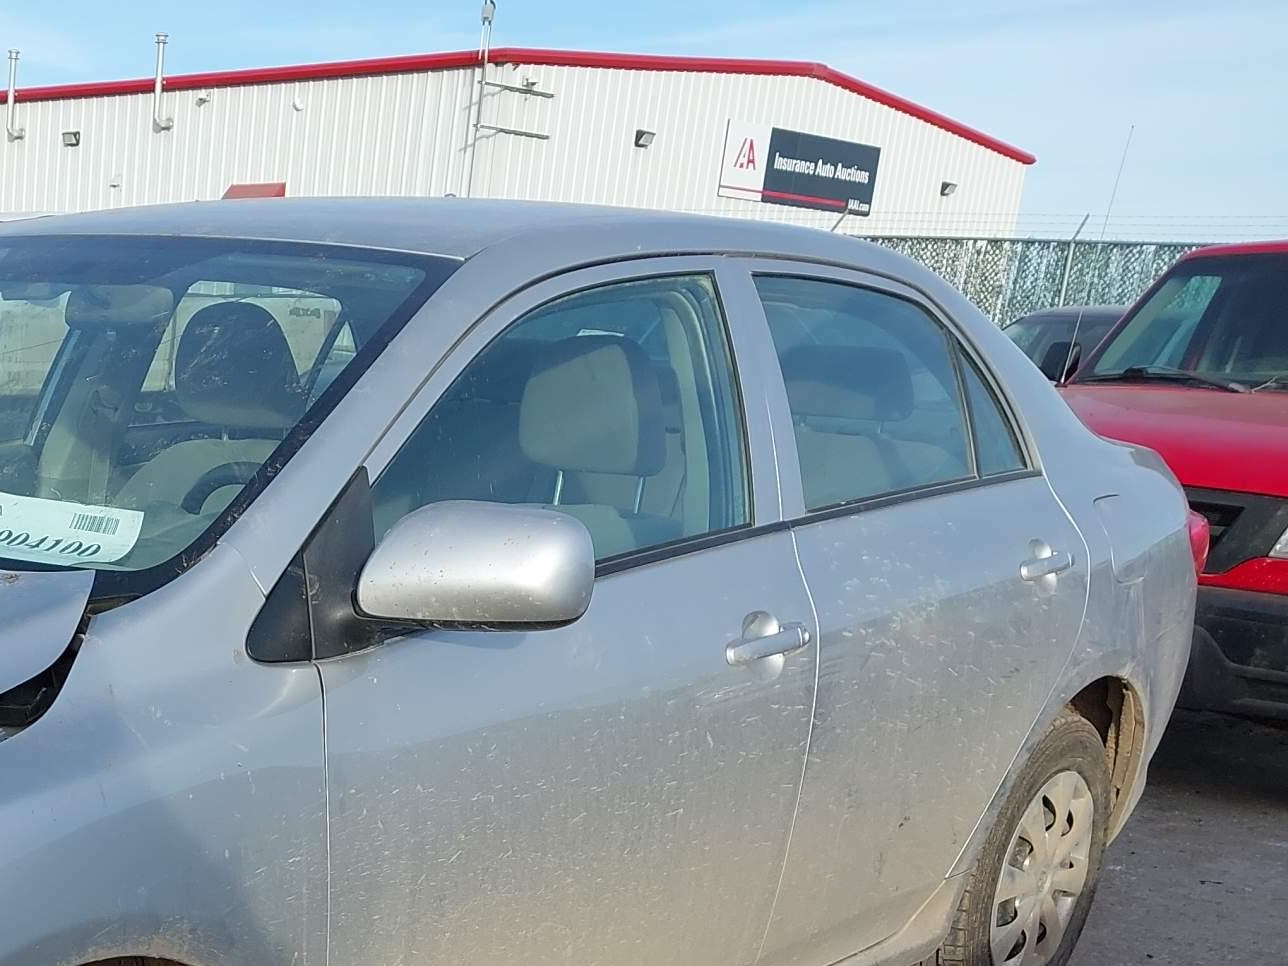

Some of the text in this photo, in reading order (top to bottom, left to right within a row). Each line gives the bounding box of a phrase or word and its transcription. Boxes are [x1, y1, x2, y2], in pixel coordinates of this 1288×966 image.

[773, 151, 870, 184] Insurance Auto Auctions
